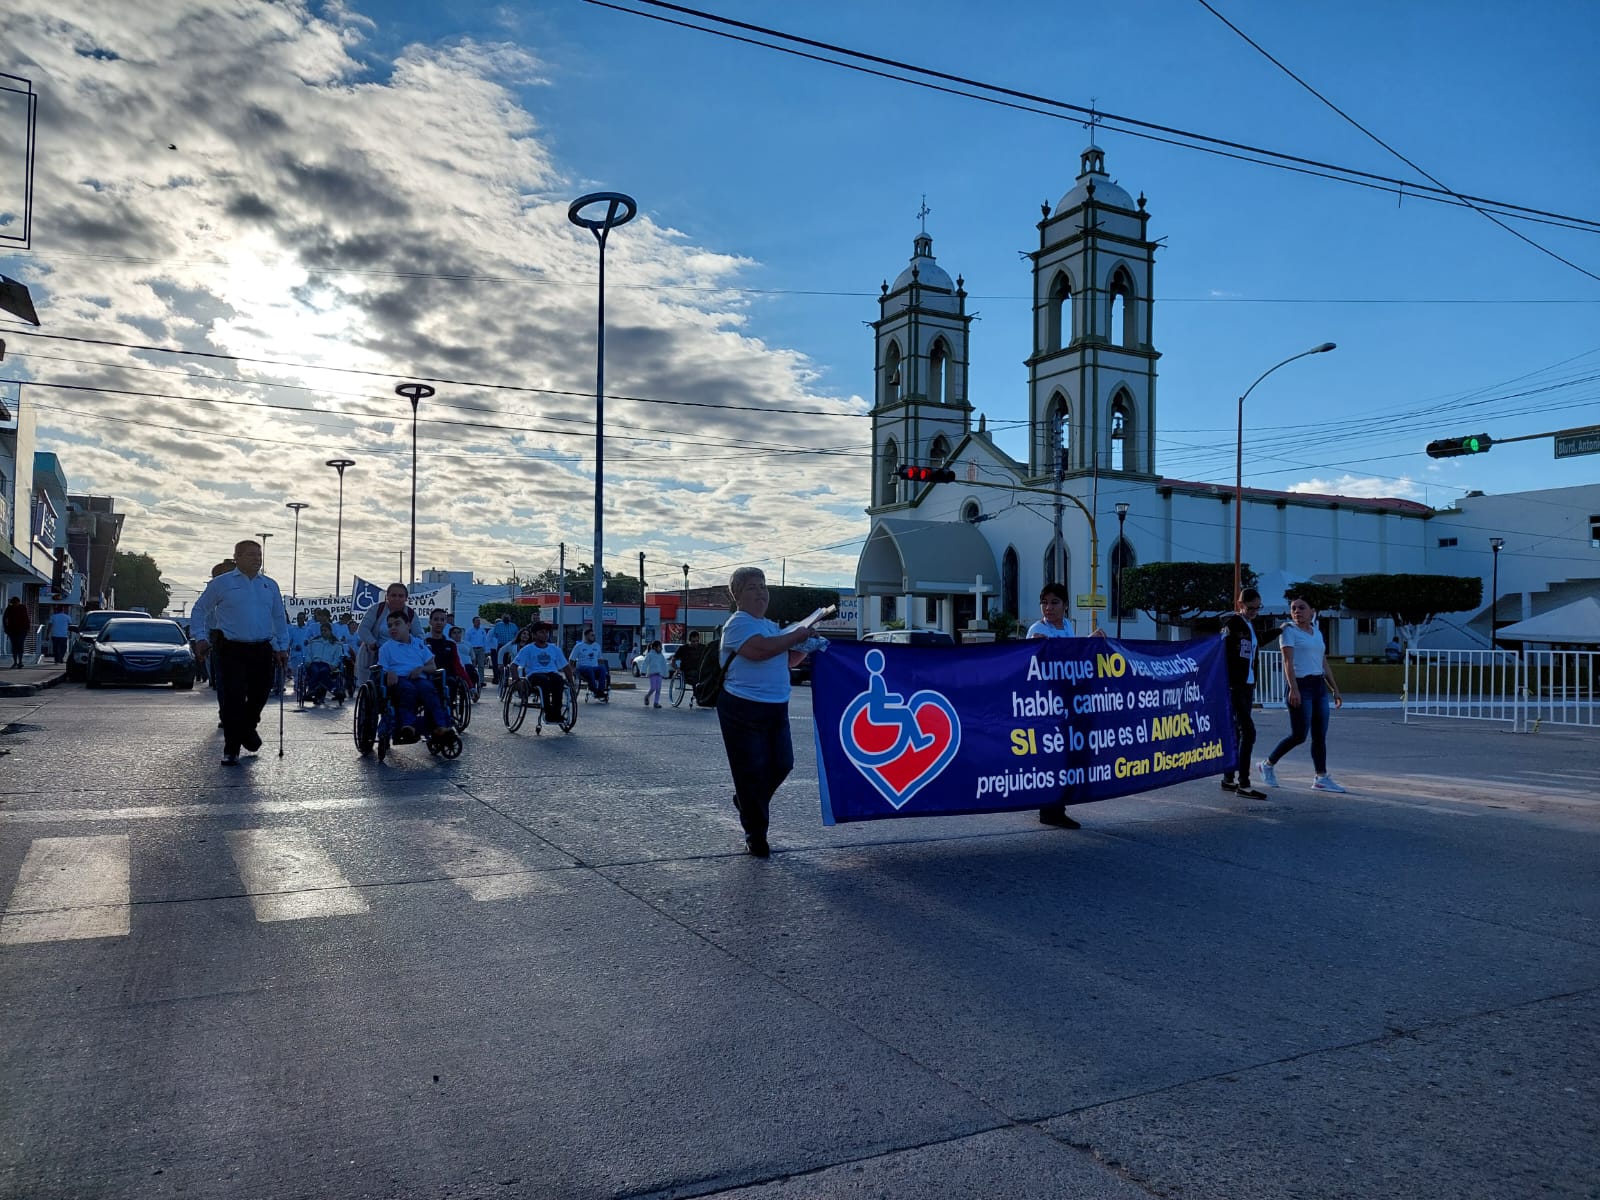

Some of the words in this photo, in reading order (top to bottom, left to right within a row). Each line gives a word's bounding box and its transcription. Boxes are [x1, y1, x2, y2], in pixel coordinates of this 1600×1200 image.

[289, 598, 305, 606] DIA
[1027, 655, 1094, 686] Aunque
[1096, 653, 1127, 678] NO
[1012, 689, 1069, 719] hable,
[1073, 686, 1124, 715] camine
[1127, 691, 1135, 710] o
[1138, 689, 1160, 709] sea
[1010, 727, 1038, 756] SI
[1068, 725, 1085, 751] lo
[1088, 728, 1116, 755] que
[1118, 726, 1134, 746] es
[1136, 718, 1149, 744] el
[1195, 711, 1211, 733] los
[976, 766, 1055, 799] prejuicios
[1058, 766, 1085, 787] son
[1088, 763, 1112, 783] una
[1114, 756, 1151, 779] Gran
